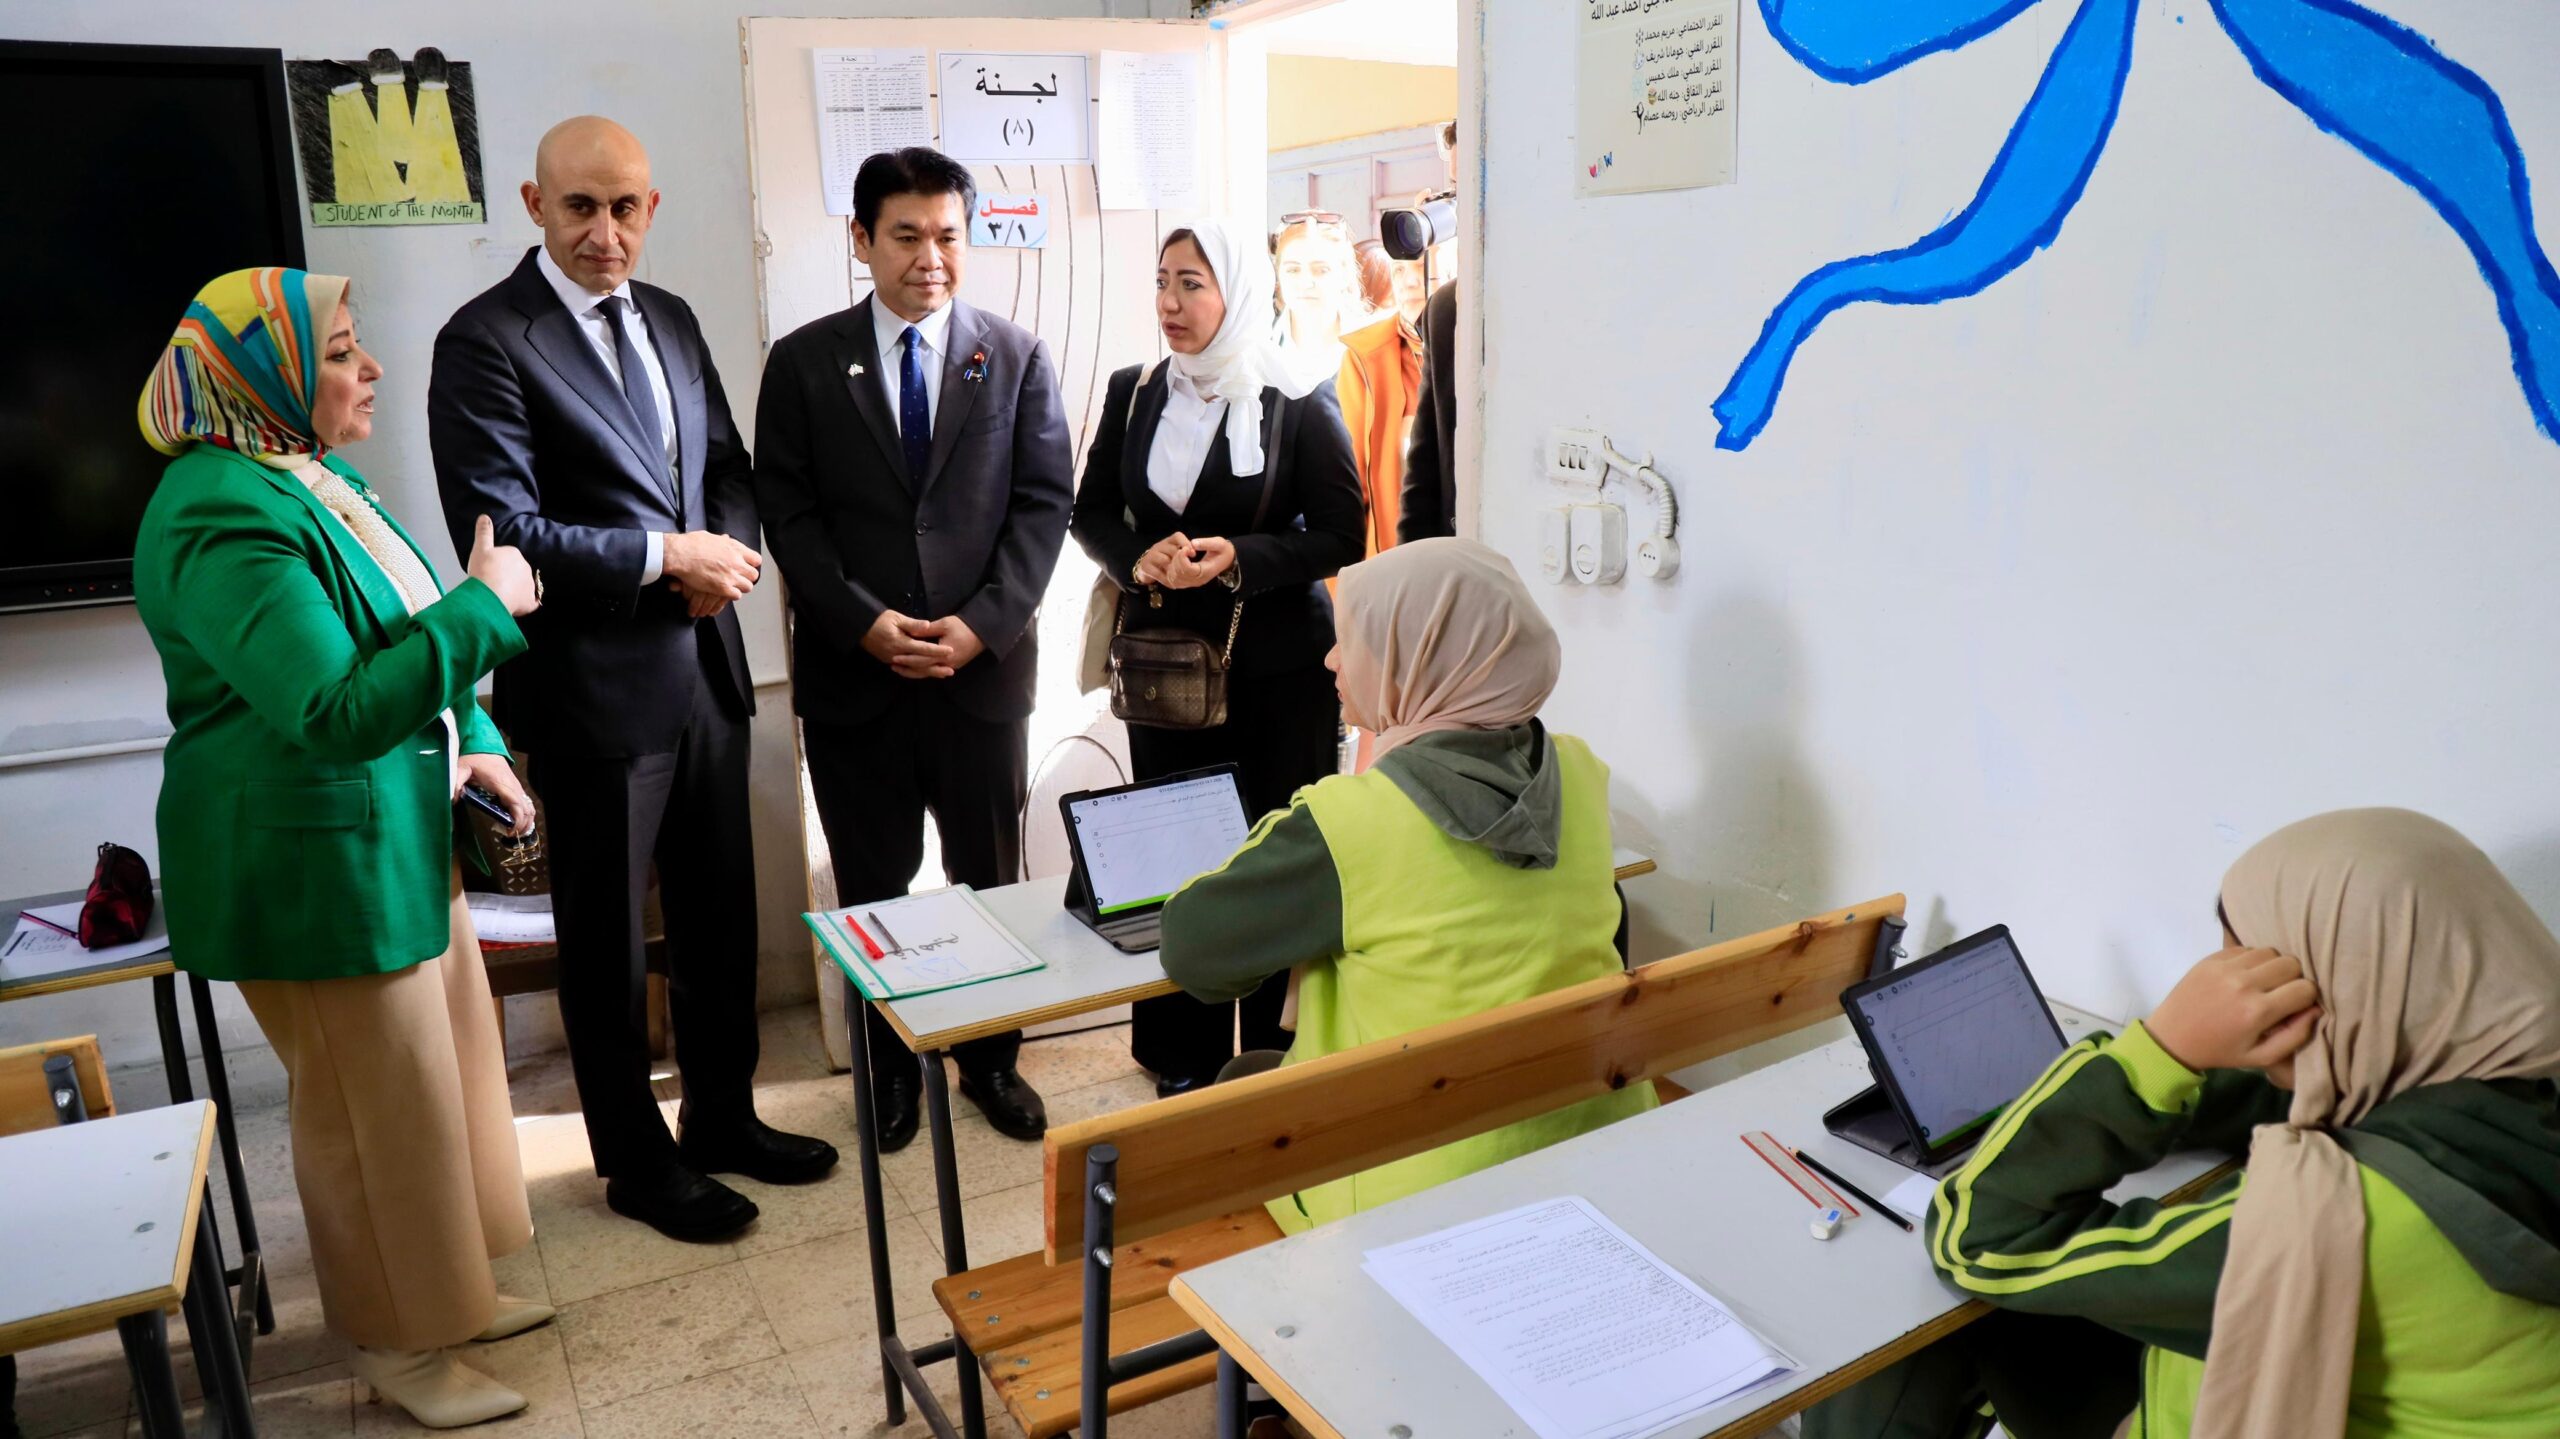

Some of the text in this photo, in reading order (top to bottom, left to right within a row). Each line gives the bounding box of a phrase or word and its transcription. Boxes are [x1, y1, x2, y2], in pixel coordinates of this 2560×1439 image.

[1591, 4, 1604, 20] الله
[1606, 4, 1619, 20] عبد
[975, 67, 1058, 104] لجنة
[326, 204, 387, 222] STUDENT
[406, 204, 425, 217] THE
[979, 198, 1040, 218] فصل
